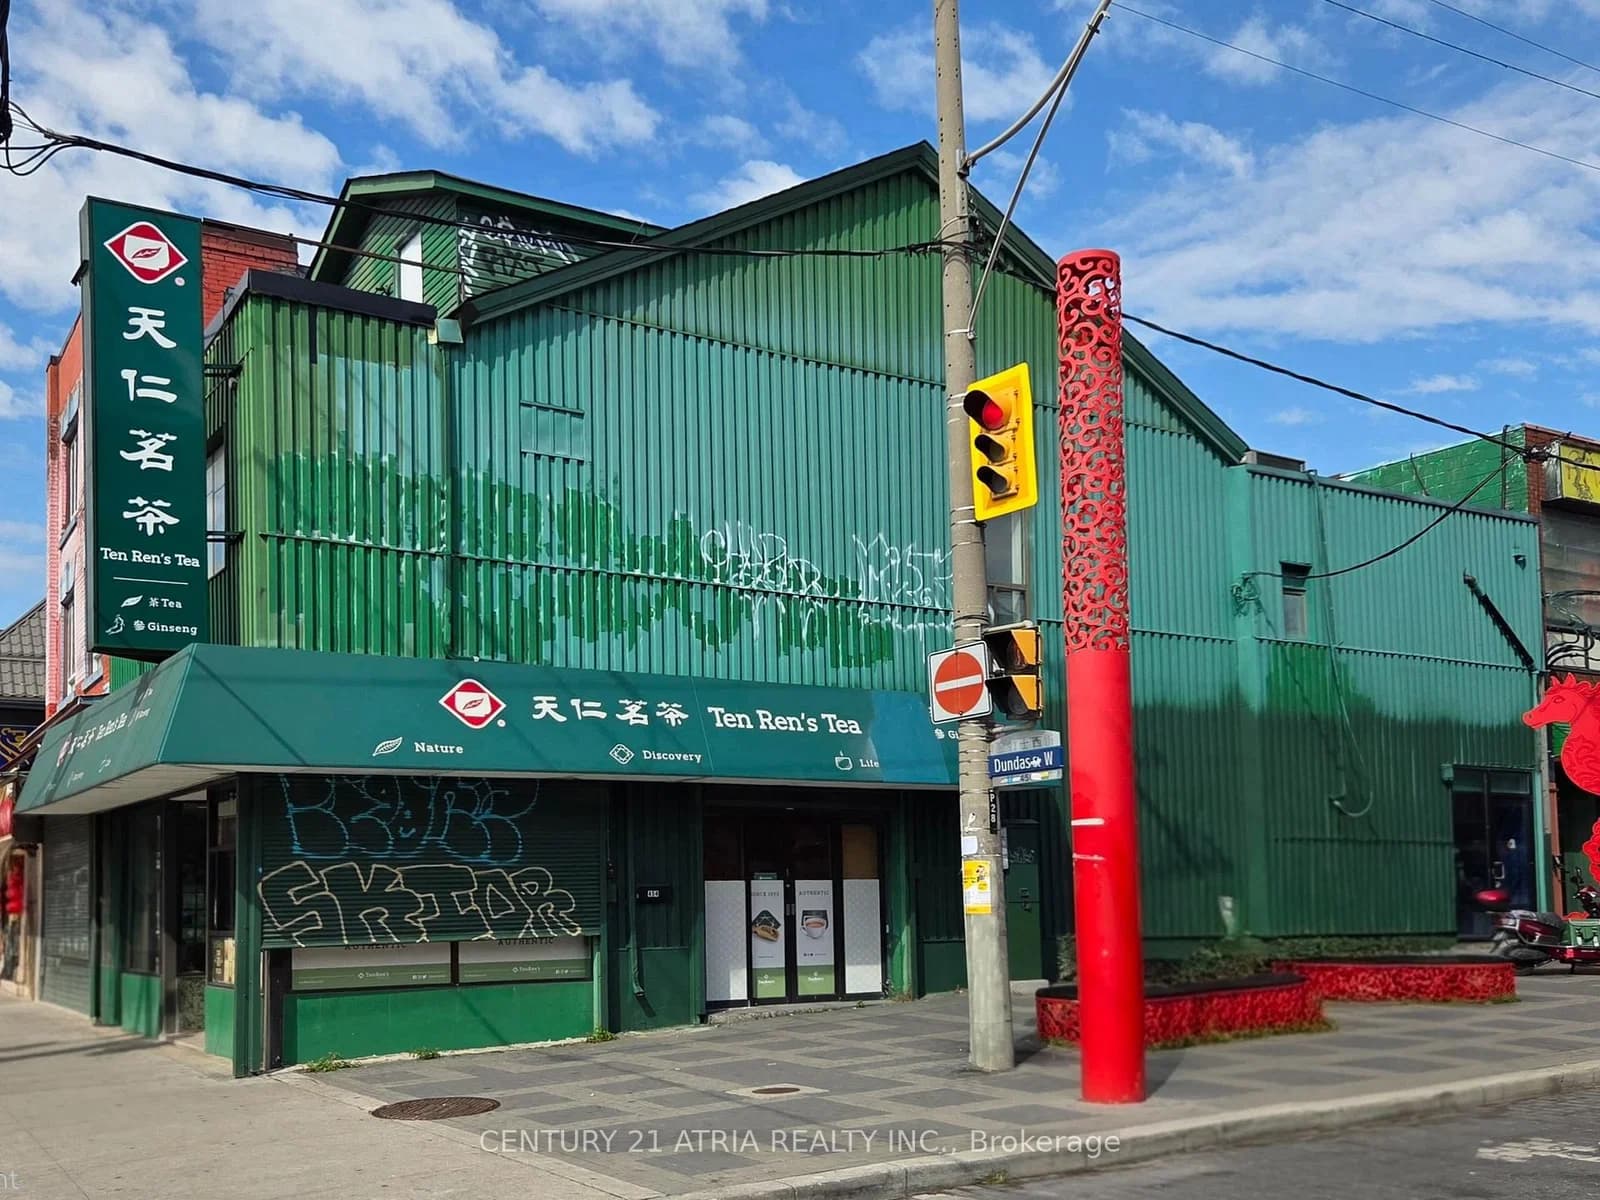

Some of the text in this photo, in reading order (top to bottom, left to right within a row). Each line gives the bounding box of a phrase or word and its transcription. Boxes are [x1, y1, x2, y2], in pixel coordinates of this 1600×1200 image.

[119, 306, 180, 537] 天仁茗茶
[100, 547, 201, 568] Ten Ren's Tea
[161, 598, 183, 609] Tea
[147, 622, 198, 636] Ginseng
[532, 696, 689, 727] 天仁茗茶
[707, 706, 863, 735] Ten Ren's Tea
[413, 742, 464, 754] Nature
[642, 750, 702, 764] Discovery
[859, 759, 880, 768] Life
[994, 756, 1032, 773] Dundas
[1043, 750, 1054, 766] W
